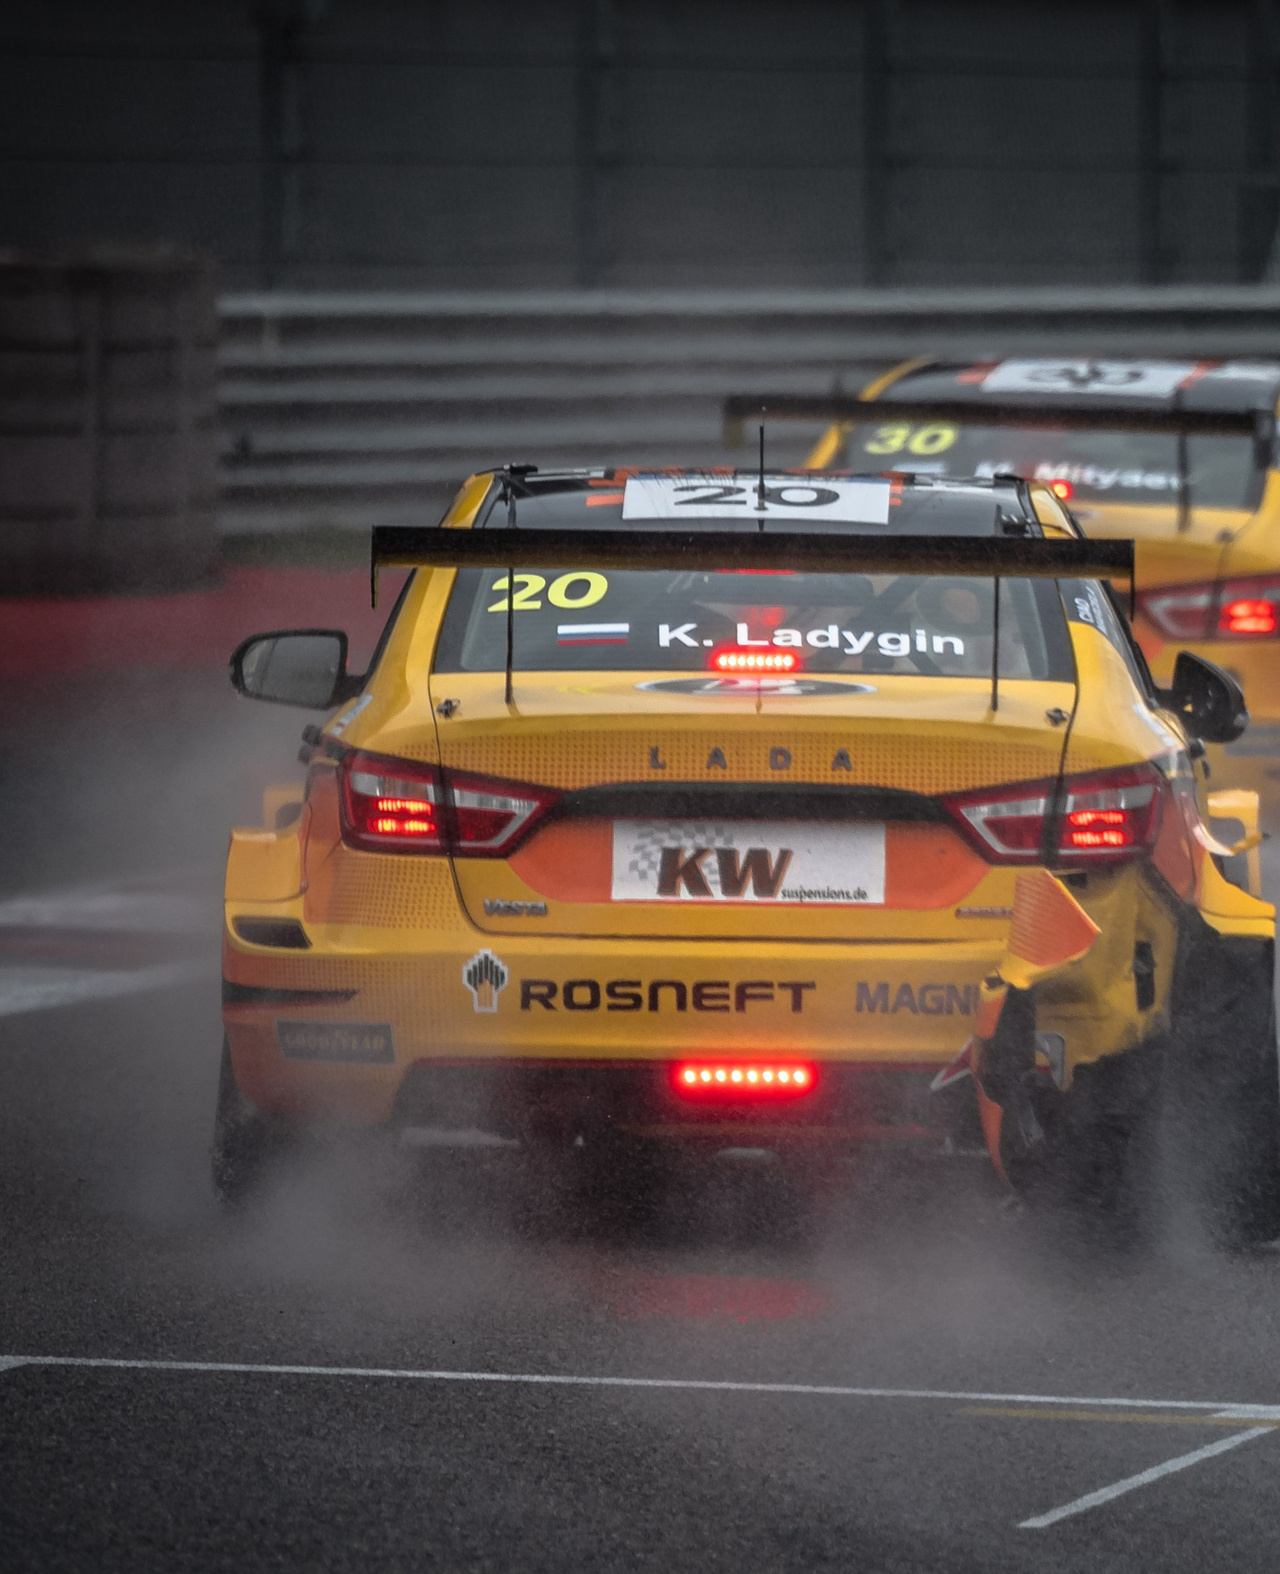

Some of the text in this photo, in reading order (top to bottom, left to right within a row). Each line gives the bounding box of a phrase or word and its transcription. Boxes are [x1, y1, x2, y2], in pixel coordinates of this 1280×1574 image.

[863, 421, 959, 456] 30
[672, 484, 840, 508] 20
[486, 571, 609, 613] 20
[657, 622, 966, 657] K. Ladygin
[648, 745, 853, 772] LADA
[656, 846, 869, 903] KW suspensions.de
[519, 978, 817, 1014] ROSNEFT
[855, 980, 980, 1016] MAGN
